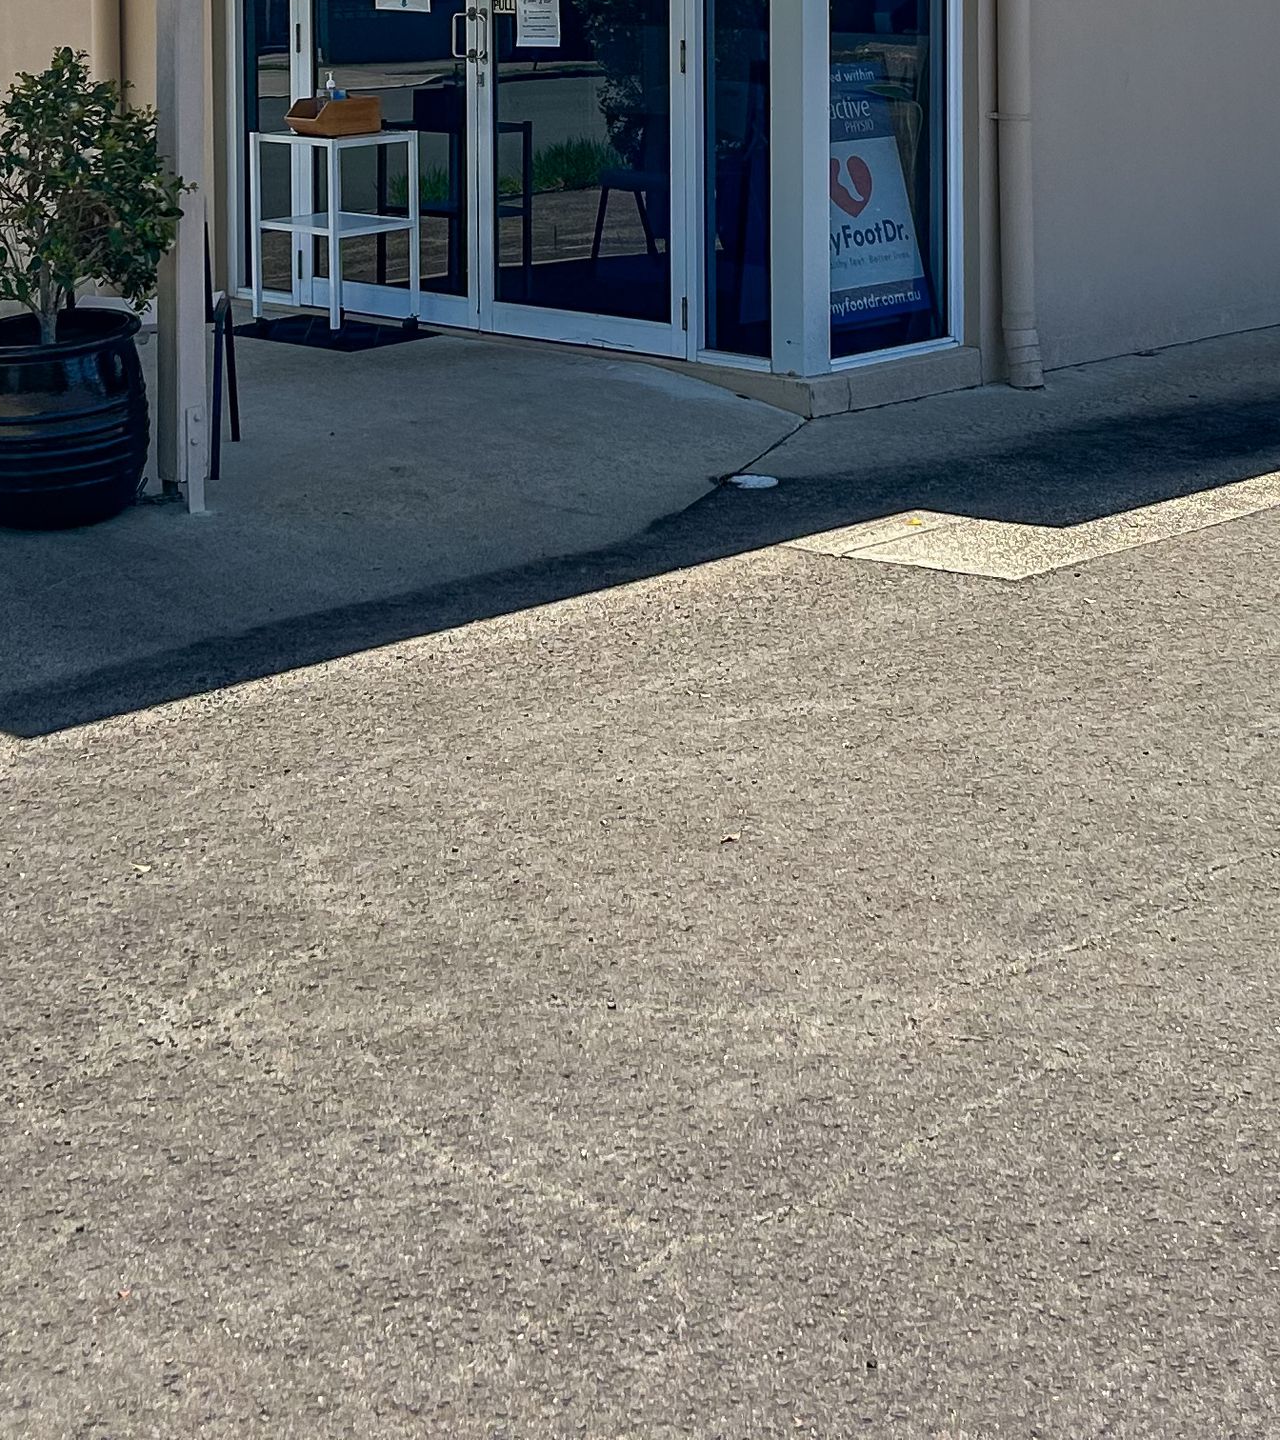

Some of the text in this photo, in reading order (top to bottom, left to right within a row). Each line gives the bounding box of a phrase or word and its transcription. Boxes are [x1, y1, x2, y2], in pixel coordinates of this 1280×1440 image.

[843, 67, 875, 81] within
[844, 119, 874, 133] PHYSIO
[830, 219, 909, 256] yFootDr.
